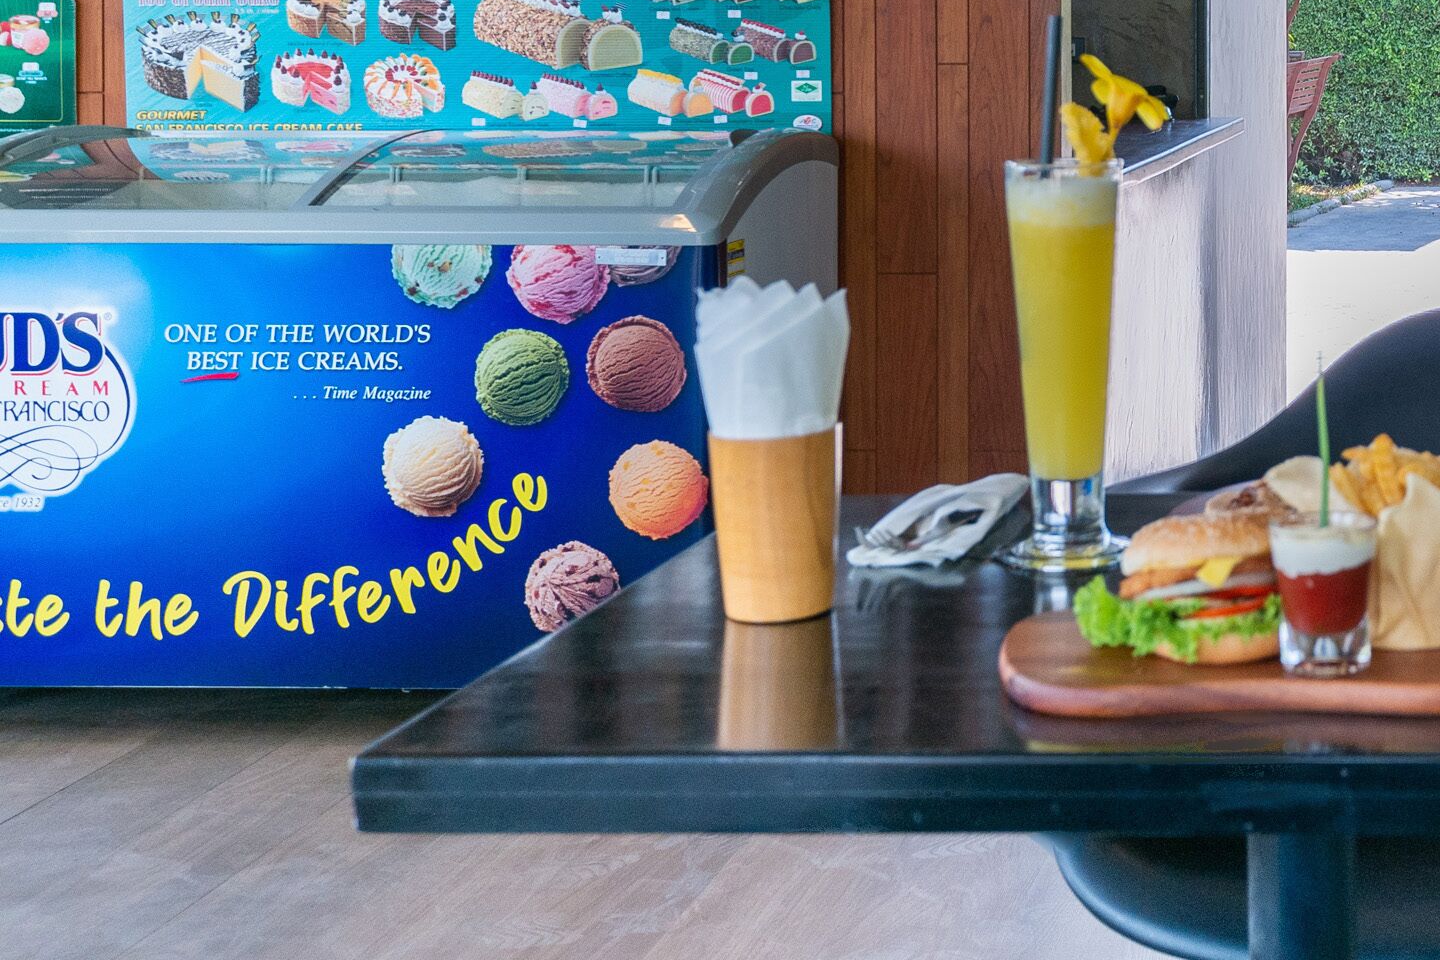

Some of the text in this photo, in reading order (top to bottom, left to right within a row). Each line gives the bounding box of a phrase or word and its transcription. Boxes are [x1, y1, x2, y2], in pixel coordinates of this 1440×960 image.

[136, 110, 207, 120] GOURMET
[168, 123, 244, 131] FRANCISCO
[0, 312, 103, 373] D'S
[164, 324, 431, 343] ONE OF THE WORLD'S
[187, 351, 403, 371] BEST ICE CREAMS.
[14, 380, 109, 396] REAM
[323, 385, 357, 400] Time
[363, 386, 431, 403] Magazine
[0, 400, 110, 422] RANCISCO
[15, 497, 41, 508] 1932
[95, 579, 200, 641] the
[222, 471, 548, 638] Difference
